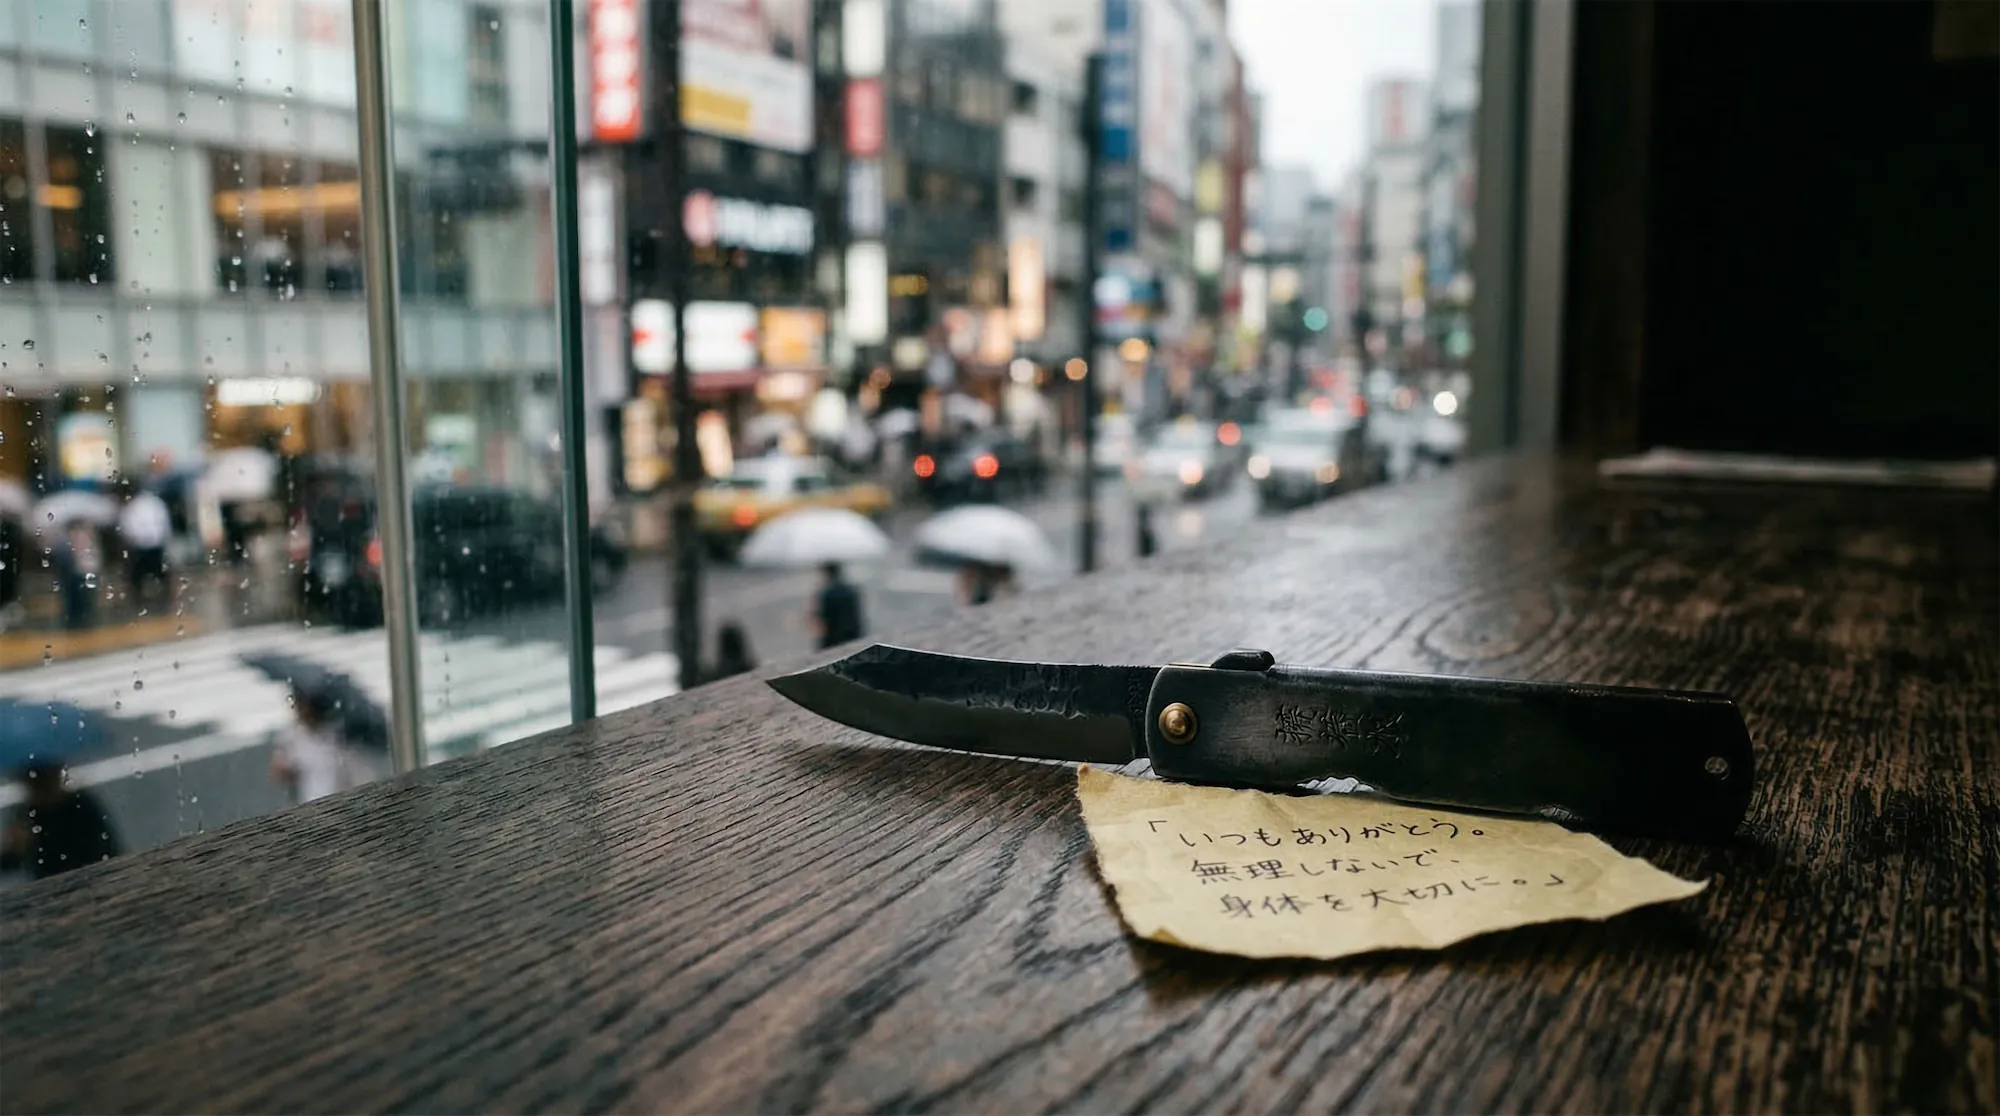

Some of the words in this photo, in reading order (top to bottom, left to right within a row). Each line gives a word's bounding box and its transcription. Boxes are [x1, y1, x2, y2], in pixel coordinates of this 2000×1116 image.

[1148, 817, 1485, 847] 「いつもありがとう。
[1190, 848, 1460, 885] 無理しないで、
